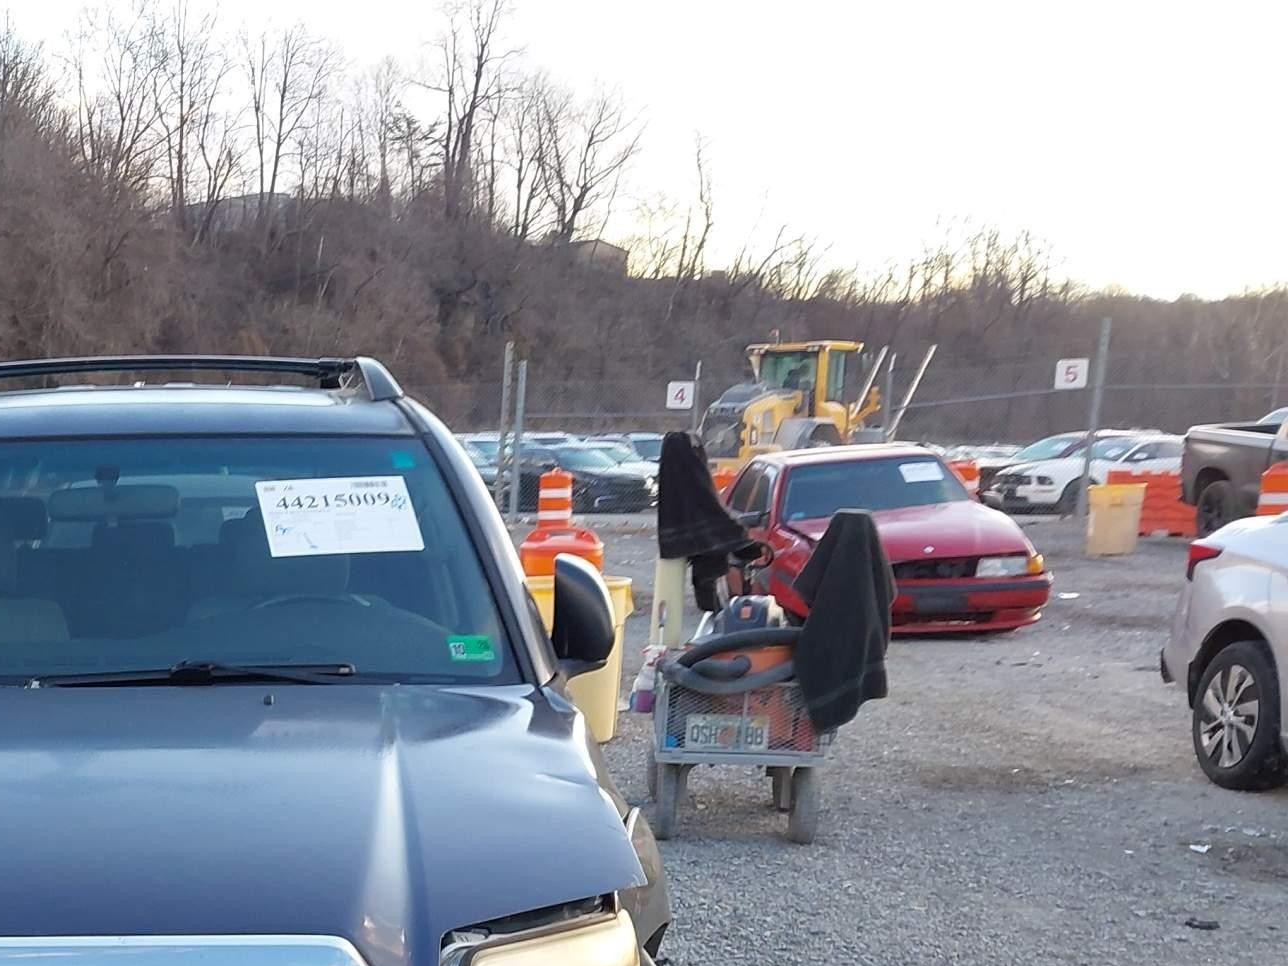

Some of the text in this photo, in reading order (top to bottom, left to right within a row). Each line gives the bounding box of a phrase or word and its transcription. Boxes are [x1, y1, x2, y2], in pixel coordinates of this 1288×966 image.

[1064, 364, 1079, 384] 5
[674, 386, 687, 404] 4
[275, 491, 390, 510] 44215009
